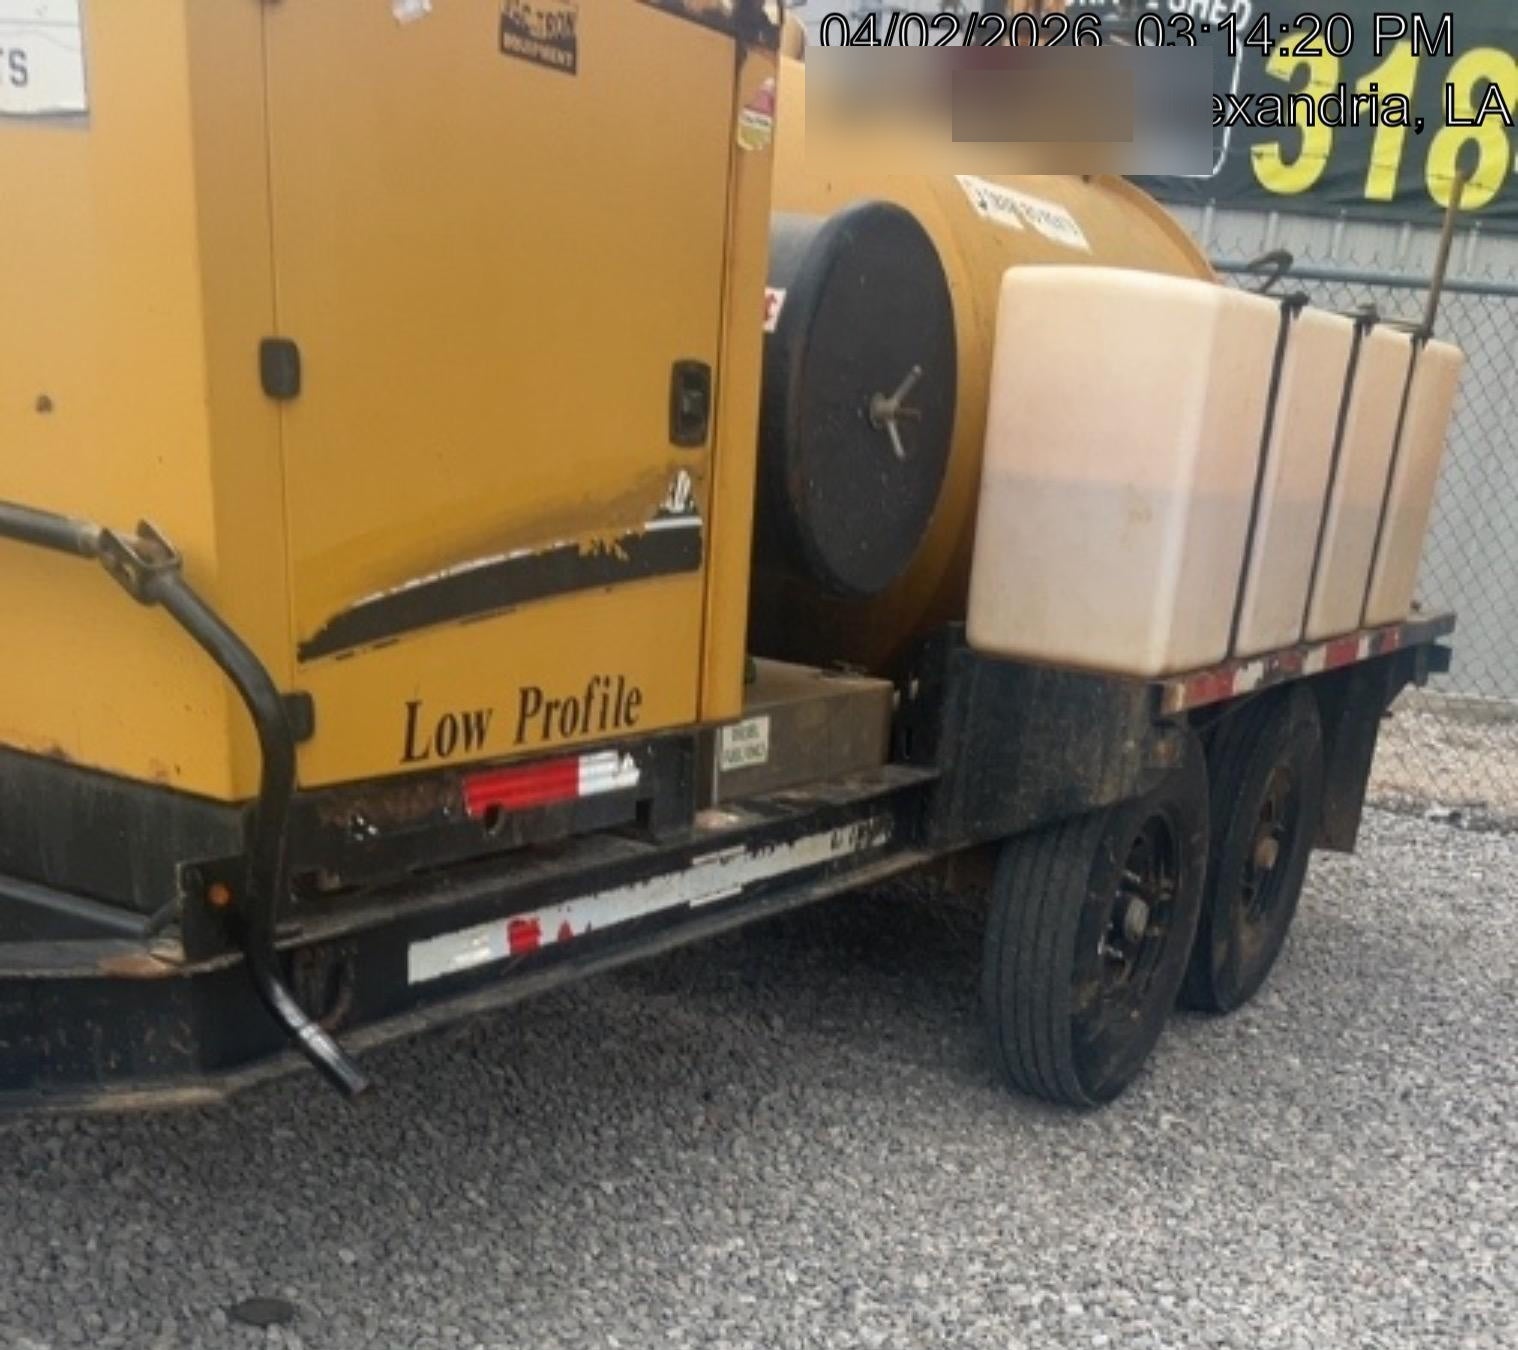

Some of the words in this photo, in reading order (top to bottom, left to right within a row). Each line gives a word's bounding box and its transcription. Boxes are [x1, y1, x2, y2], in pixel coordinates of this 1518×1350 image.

[0, 47, 28, 88] S
[400, 700, 493, 762] Low
[514, 675, 643, 744] Profile
